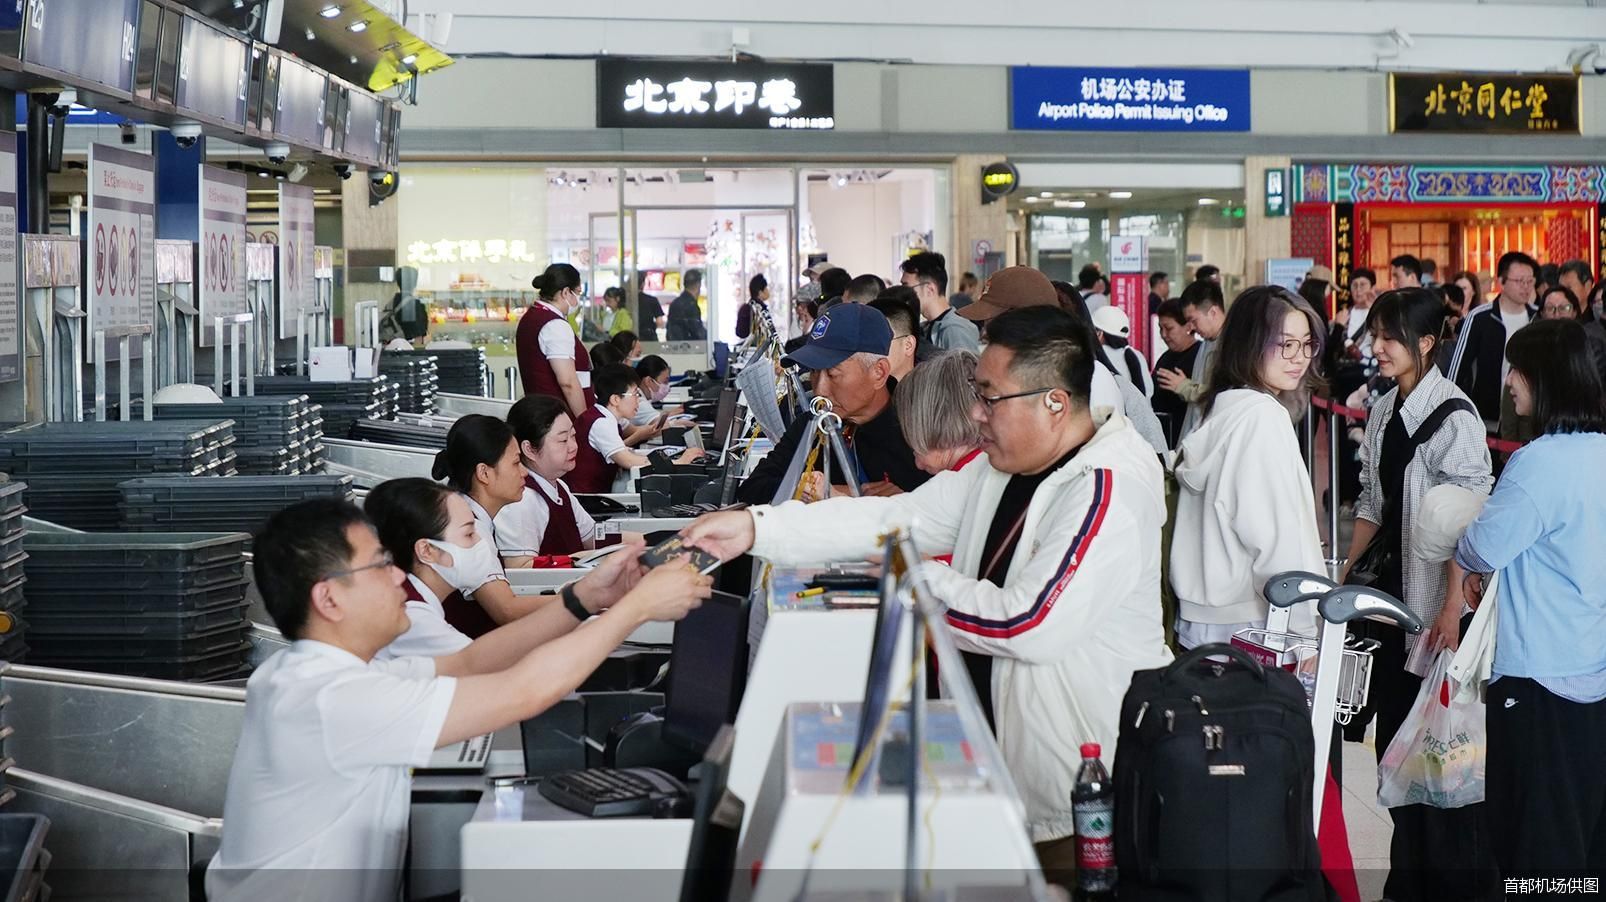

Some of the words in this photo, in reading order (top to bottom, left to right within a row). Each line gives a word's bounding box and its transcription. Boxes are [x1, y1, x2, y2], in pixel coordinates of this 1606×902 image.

[1080, 77, 1186, 102] 机场公安办证
[1424, 80, 1548, 119] 北京同仁堂
[1038, 102, 1077, 121] Airport
[1078, 103, 1114, 120] Police
[1115, 103, 1152, 120] Permit
[1152, 104, 1194, 124] Issuing
[1194, 105, 1228, 121] Office
